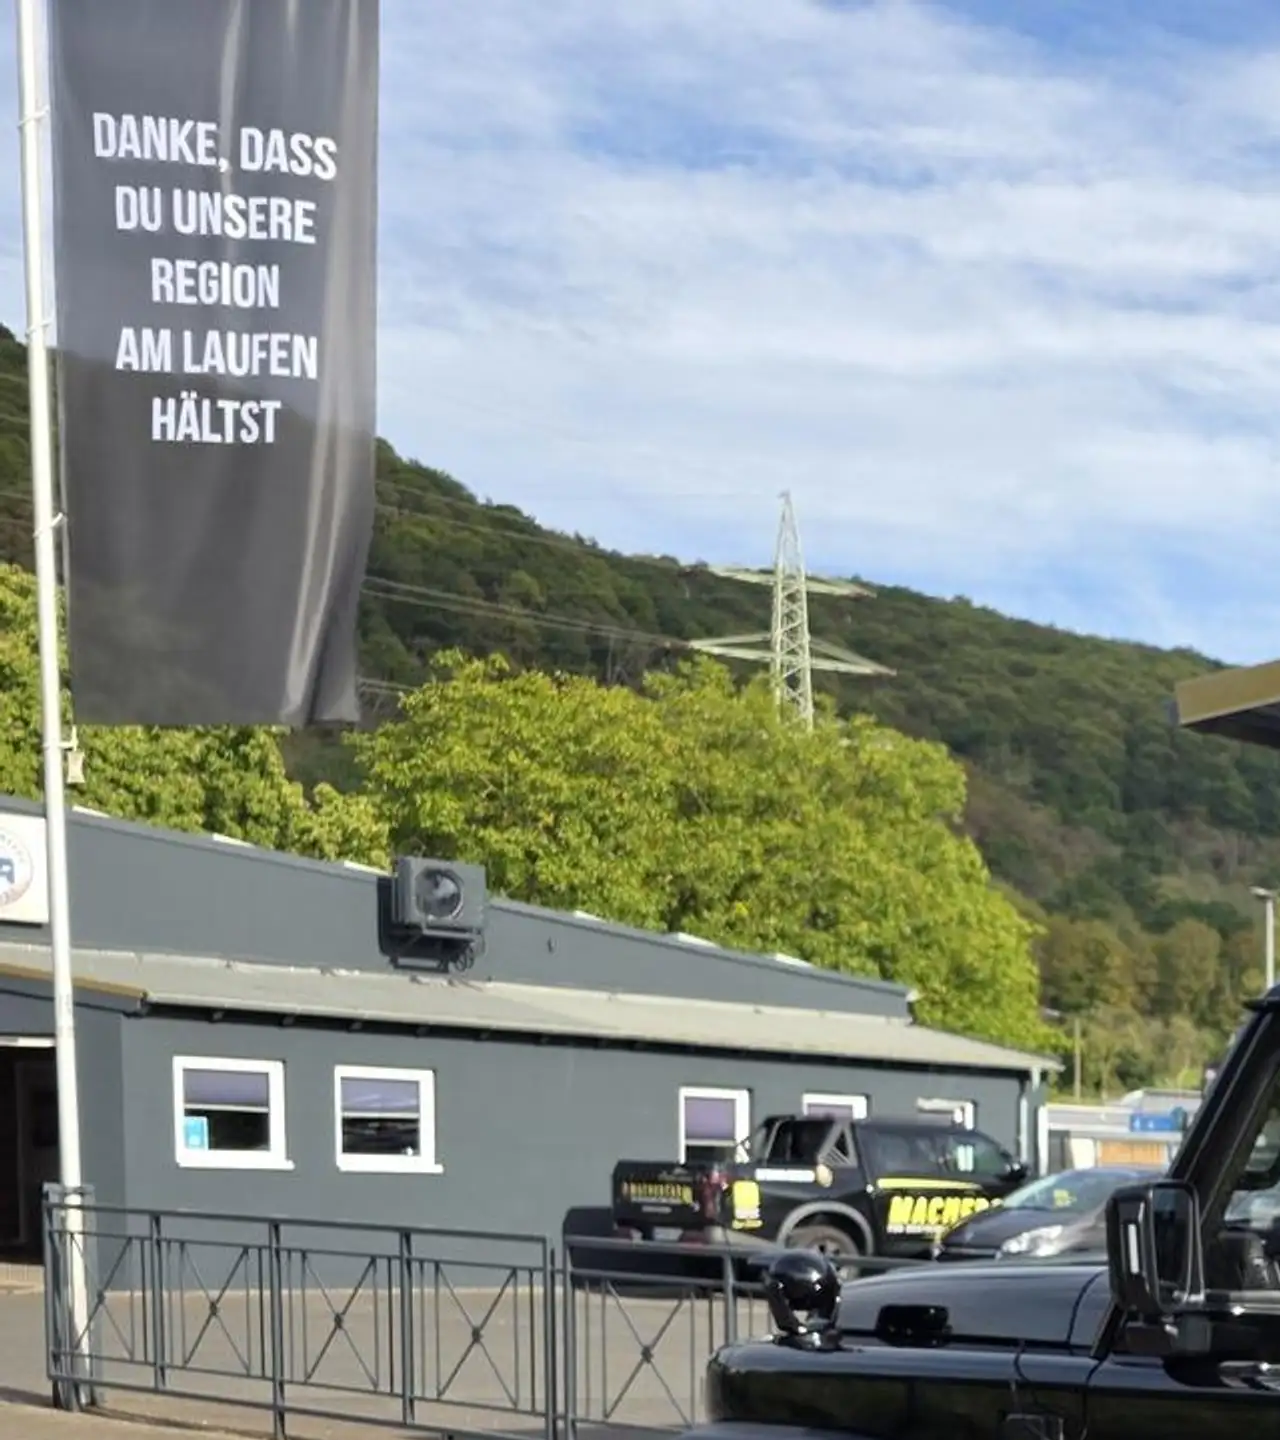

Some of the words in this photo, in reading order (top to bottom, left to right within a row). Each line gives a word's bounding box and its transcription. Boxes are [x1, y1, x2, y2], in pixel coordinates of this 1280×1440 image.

[93, 112, 231, 172] DANKE,
[240, 127, 337, 181] DASS
[115, 185, 162, 232] DU
[173, 189, 317, 245] UNSERE
[151, 258, 279, 308] REGION
[115, 327, 172, 373] AM
[183, 330, 318, 379] LAUFEN
[152, 391, 282, 444] HÄLTST
